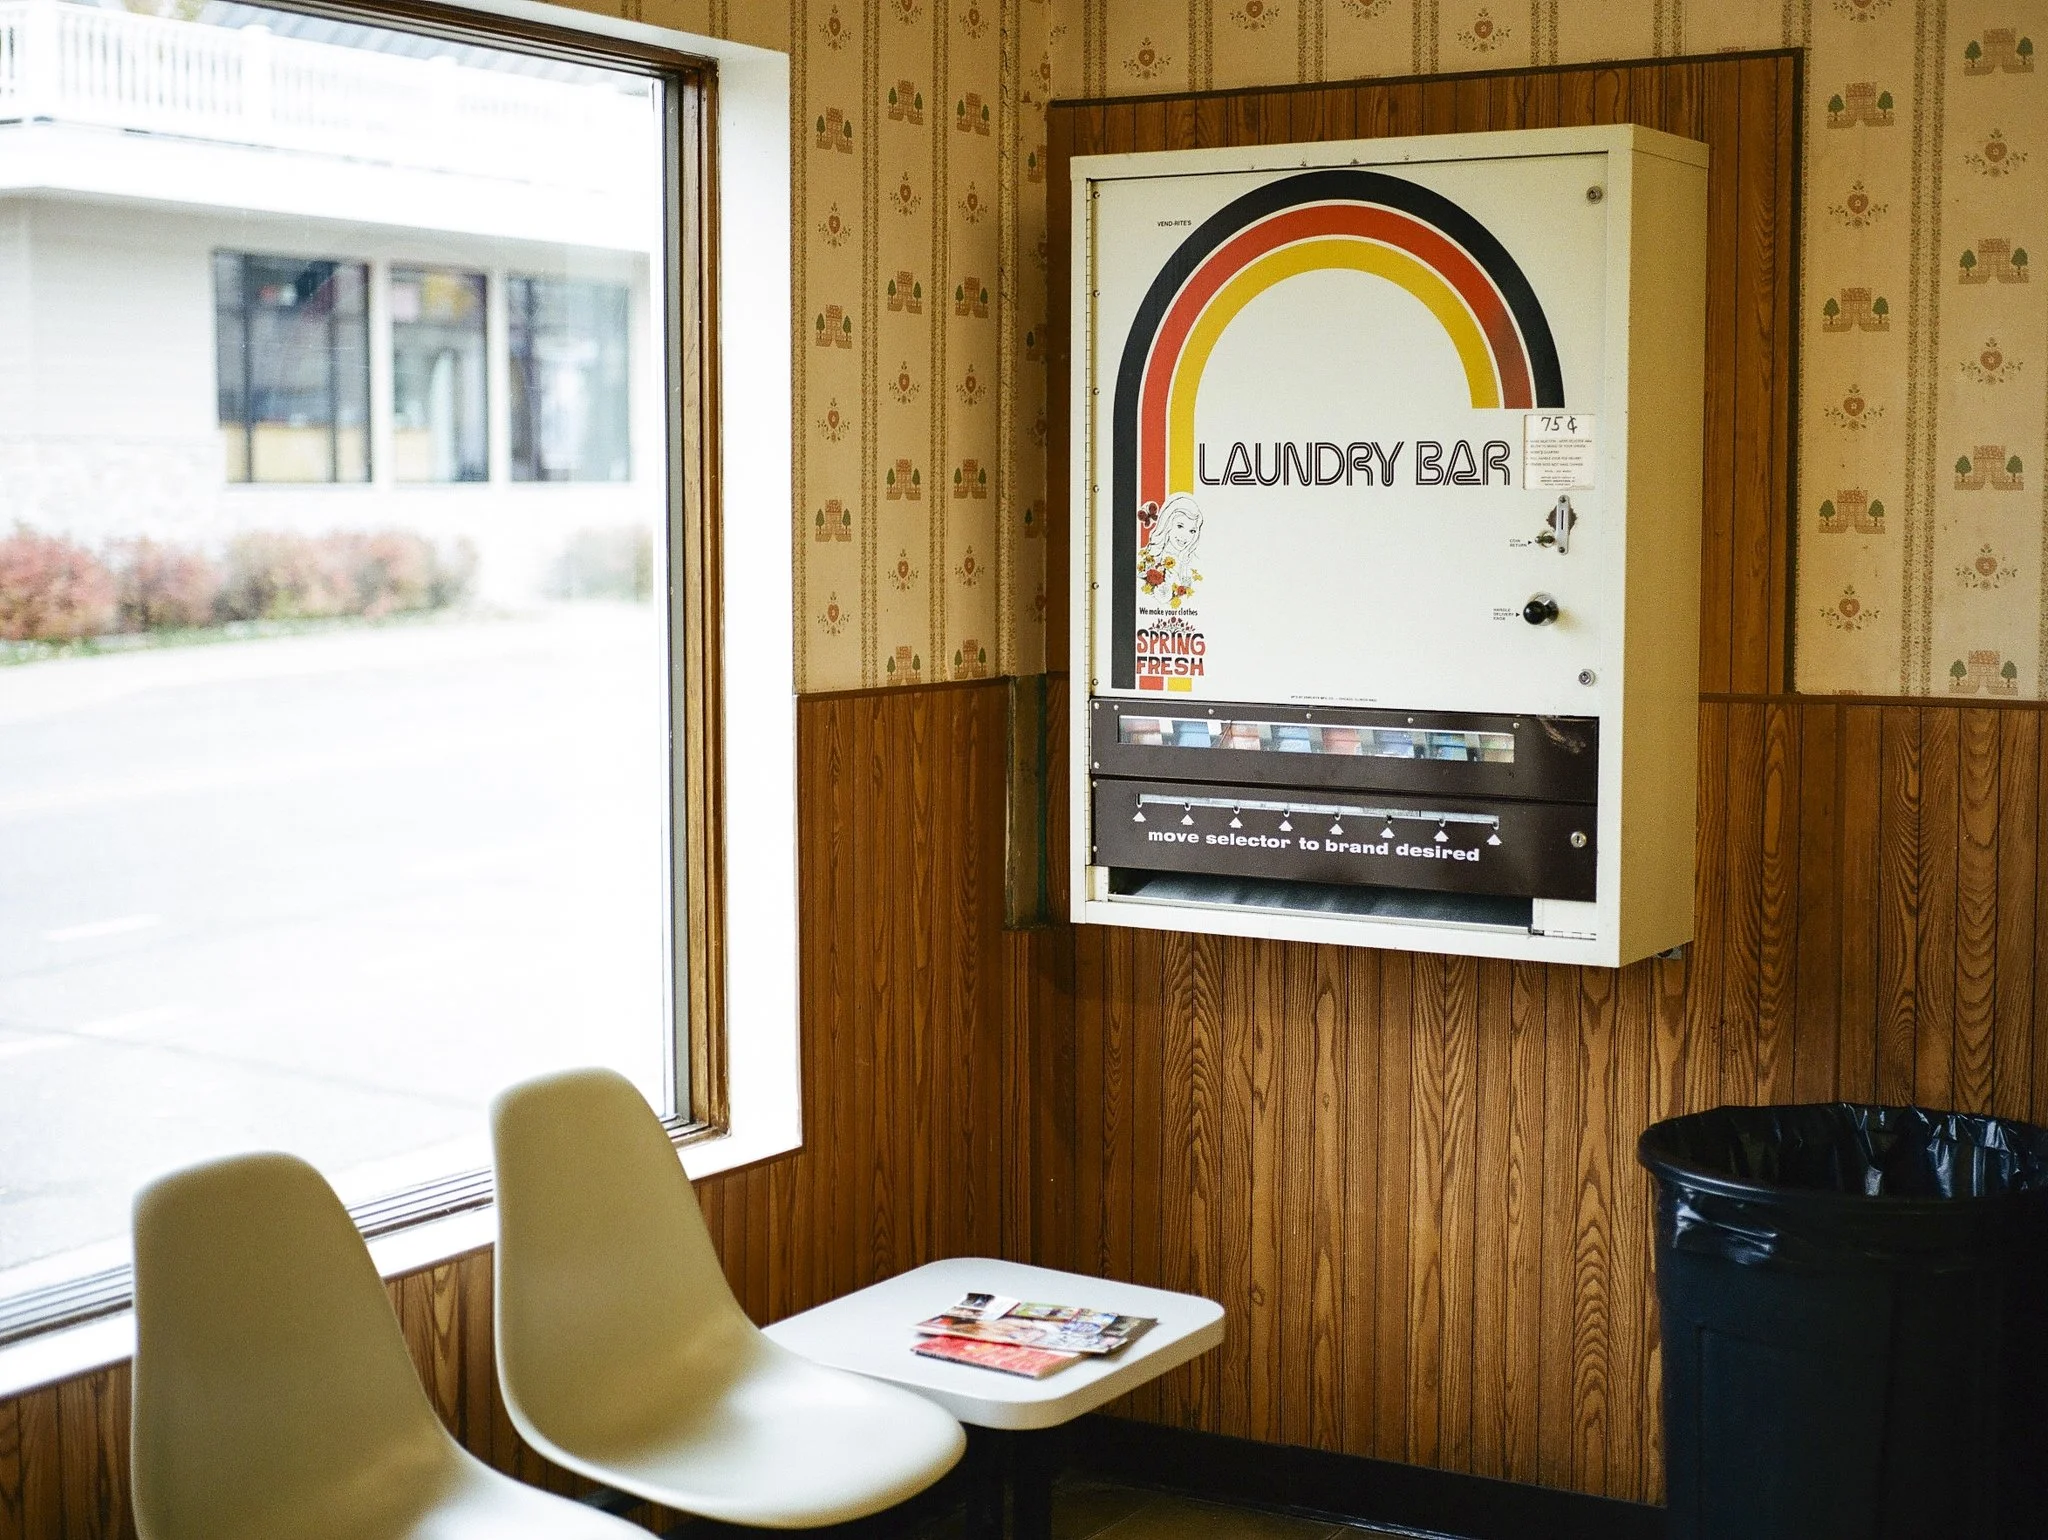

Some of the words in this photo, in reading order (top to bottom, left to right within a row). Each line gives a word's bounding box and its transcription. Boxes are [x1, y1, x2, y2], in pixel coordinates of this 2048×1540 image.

[1199, 441, 1405, 486] LAUNDRY
[1416, 440, 1511, 486] BAR
[1139, 606, 1148, 615] We
[1149, 607, 1164, 616] make
[1165, 609, 1177, 617] your
[1178, 607, 1198, 616] clothes
[1136, 628, 1206, 656] SPRING
[1136, 656, 1205, 676] FRESH
[1148, 830, 1200, 844] move
[1205, 832, 1291, 850] selector
[1299, 836, 1320, 851] to
[1325, 839, 1389, 856] brand
[1395, 843, 1480, 862] desired
